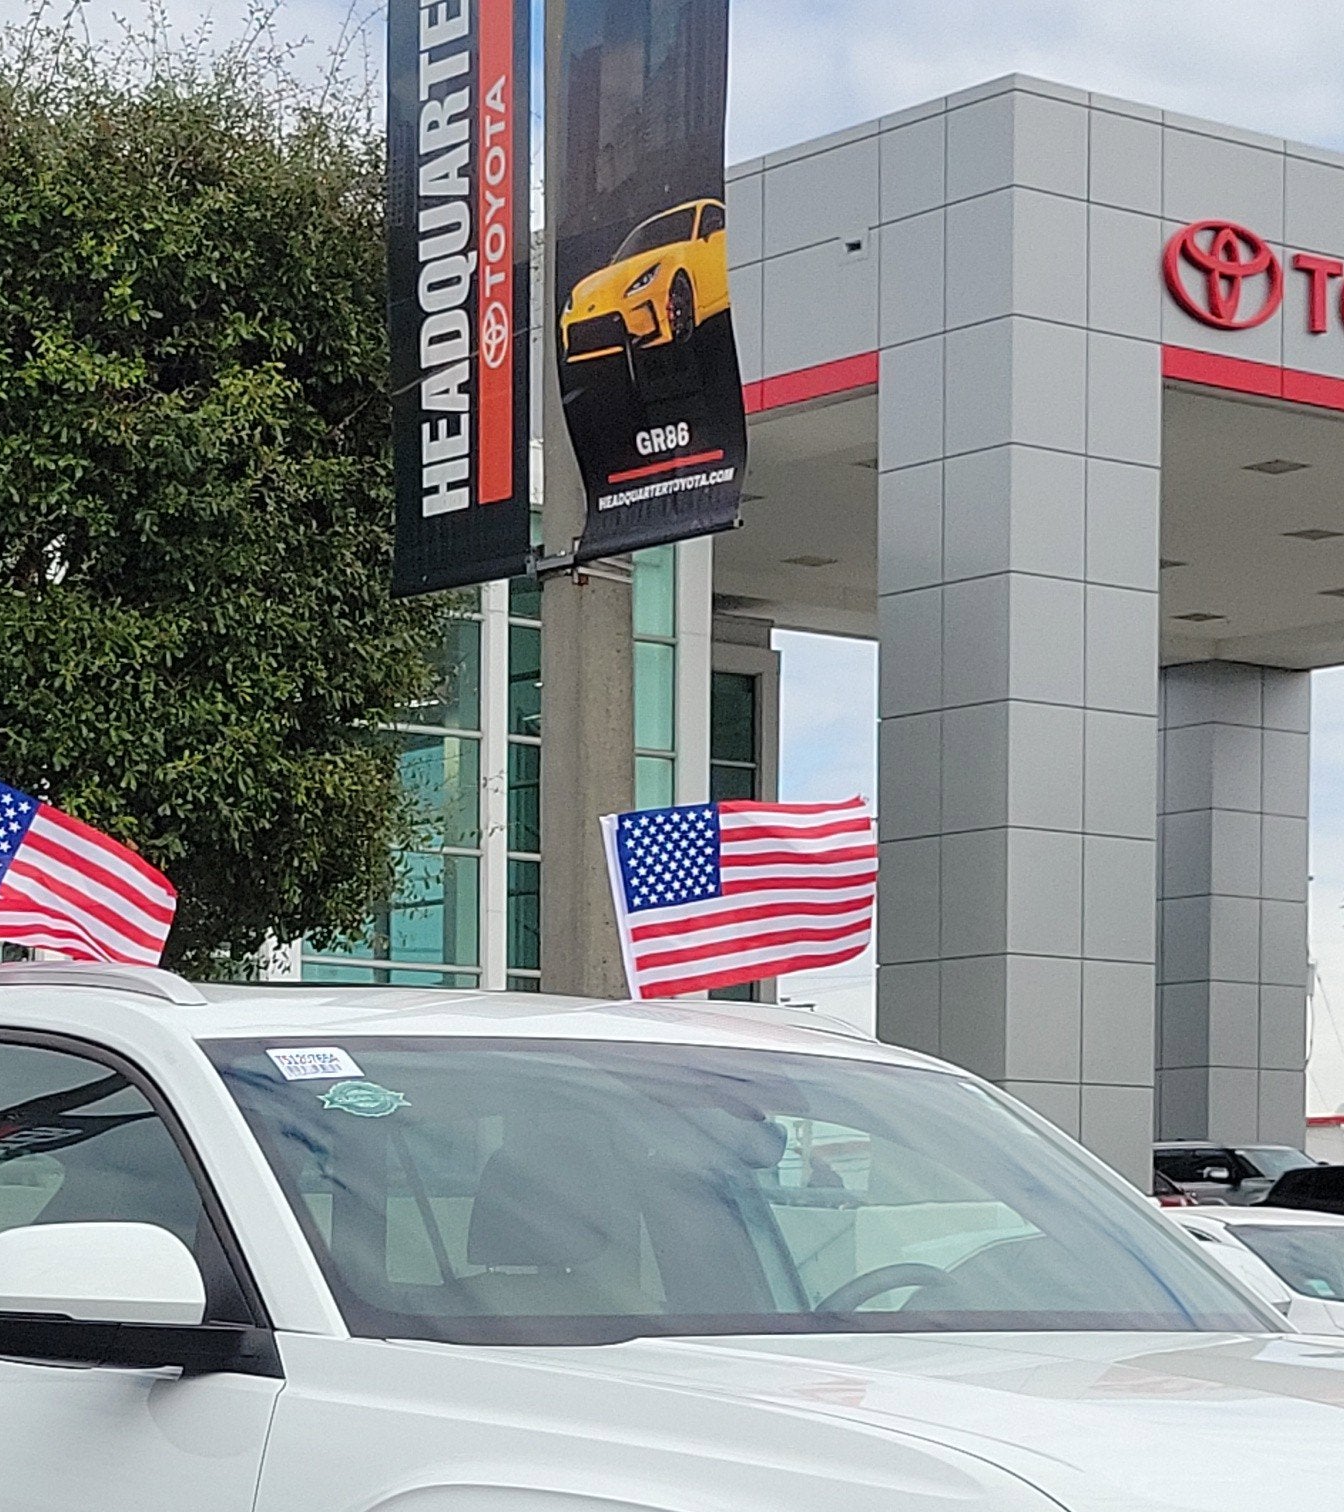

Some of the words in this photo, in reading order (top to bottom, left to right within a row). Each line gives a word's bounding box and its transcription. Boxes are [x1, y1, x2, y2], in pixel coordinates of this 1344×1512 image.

[484, 74, 506, 298] TOYOTA
[418, 0, 478, 518] HEADQUARTE
[598, 467, 735, 511] HEADQUARTERTOYOTA.COM
[635, 421, 690, 456] GR86
